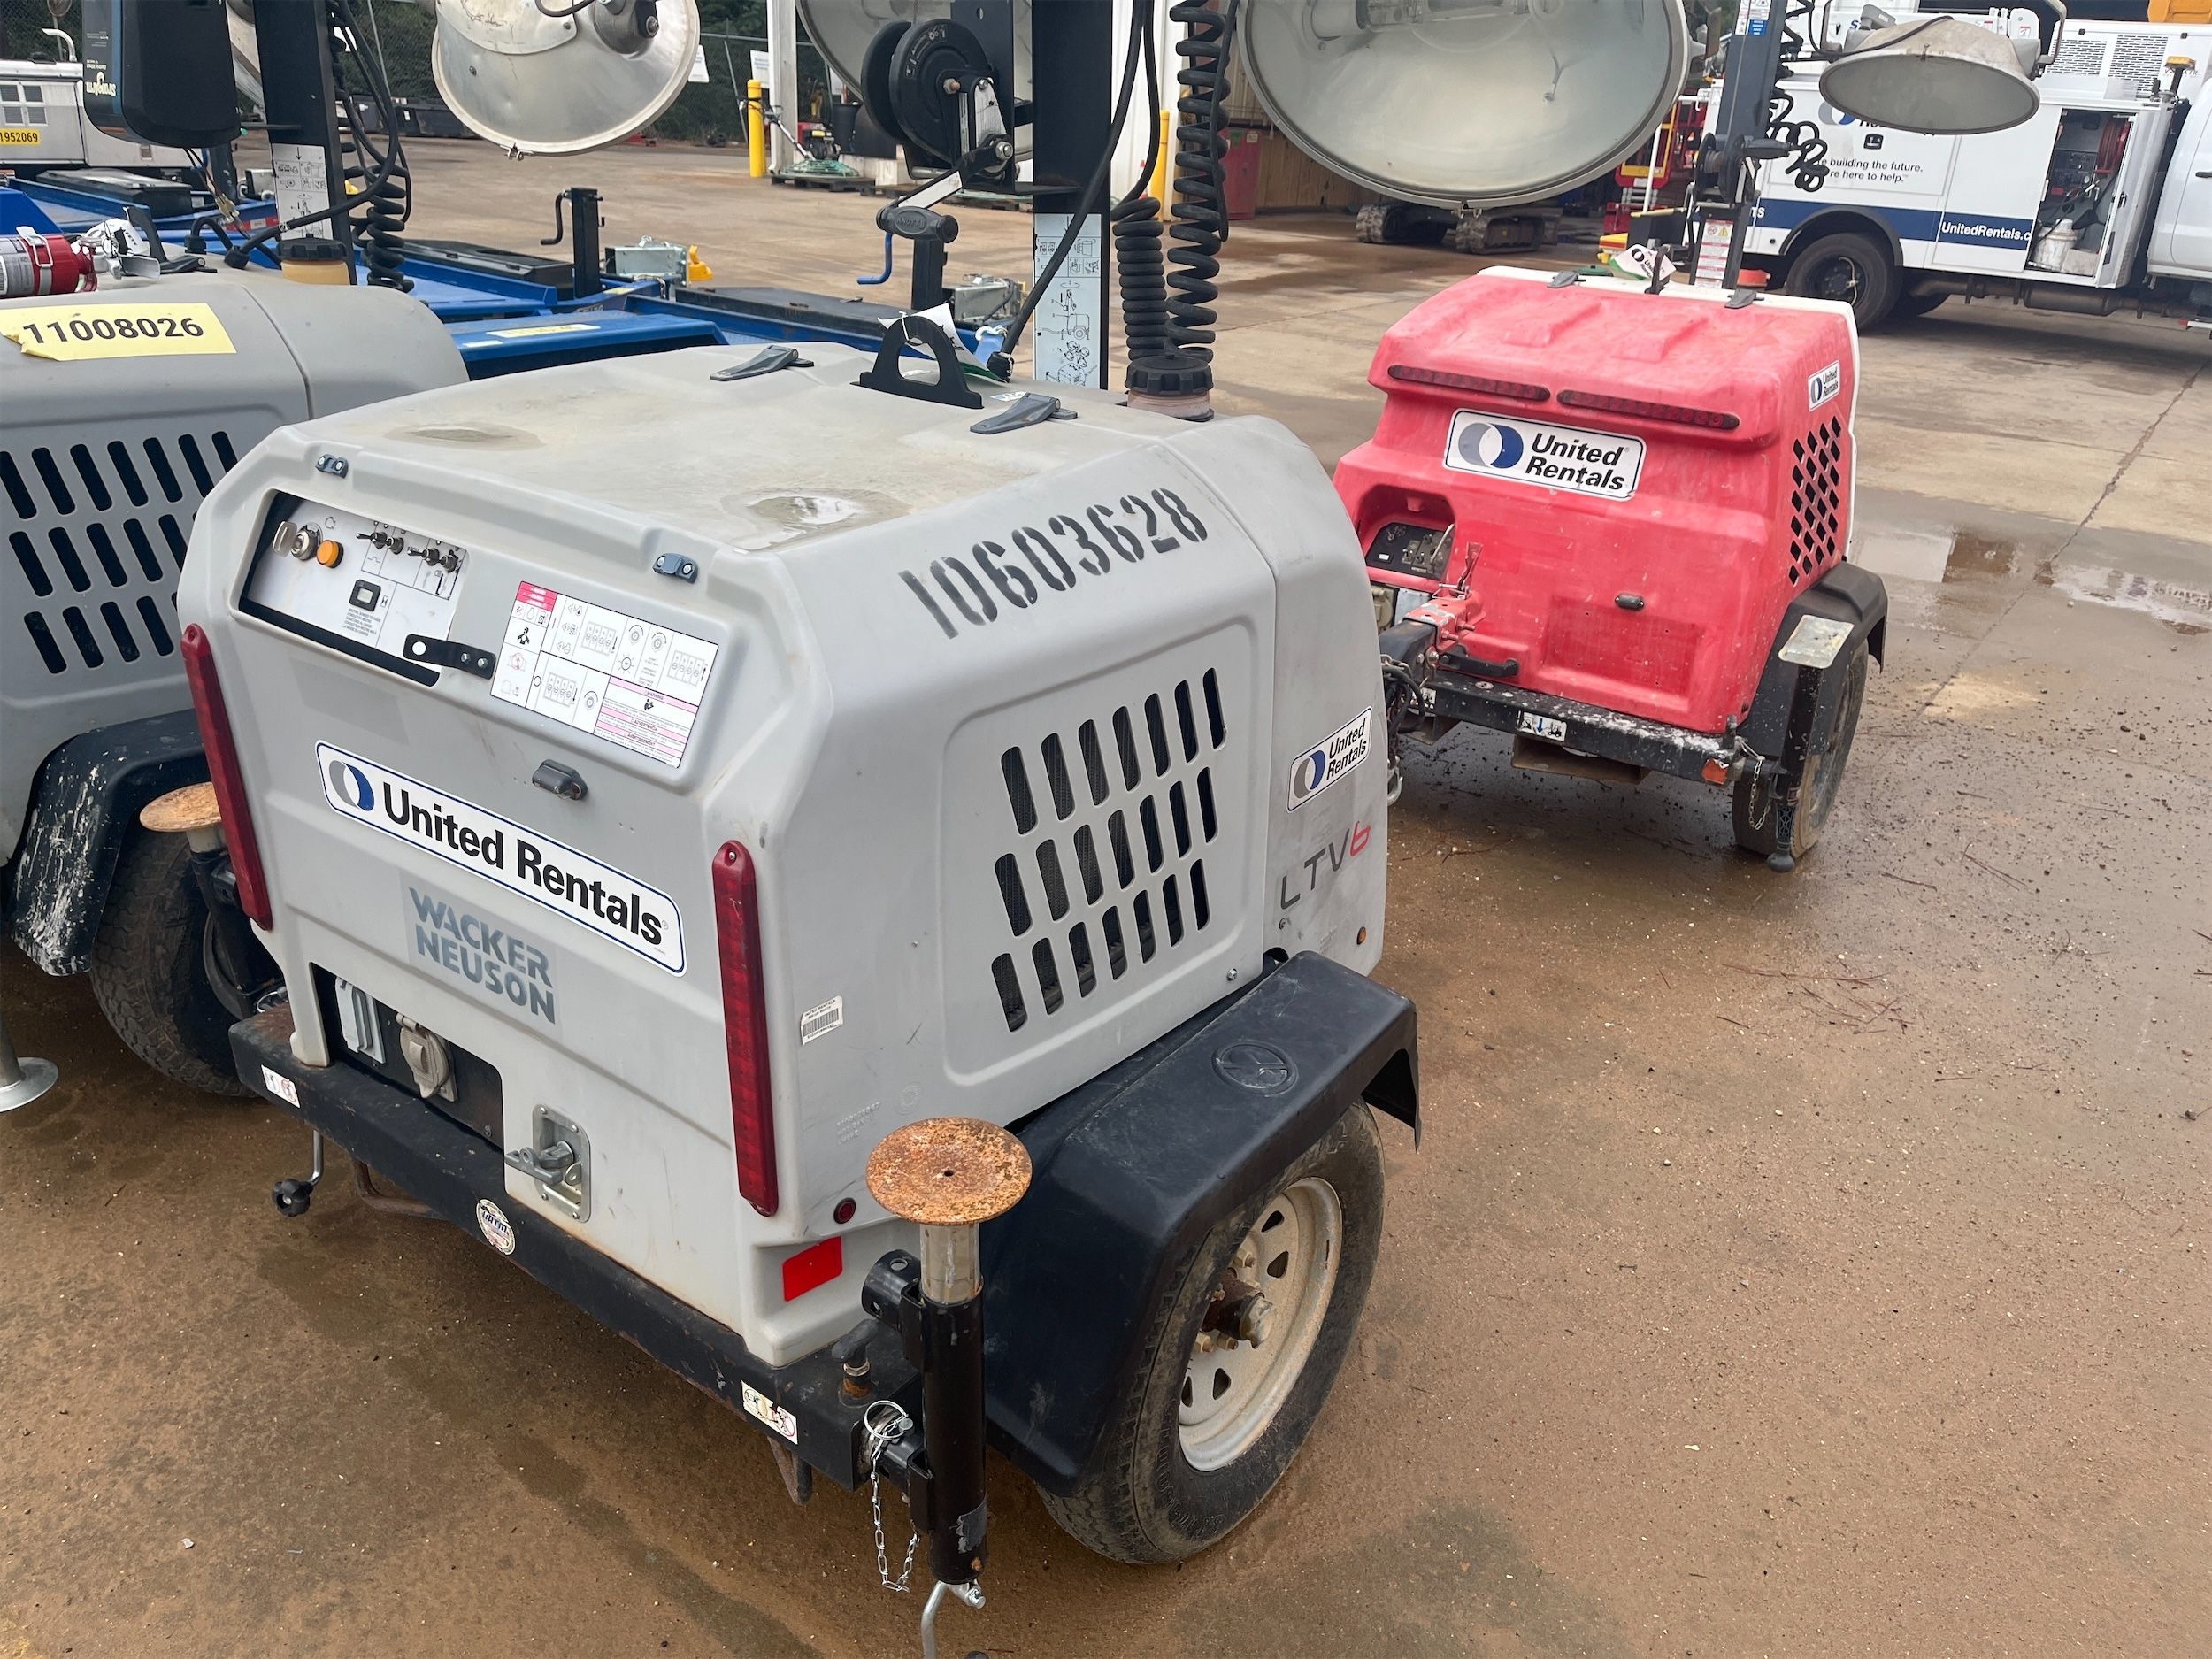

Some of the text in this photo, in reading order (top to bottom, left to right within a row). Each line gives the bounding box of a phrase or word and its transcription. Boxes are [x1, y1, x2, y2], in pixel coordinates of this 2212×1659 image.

[1829, 157, 1869, 171] building
[1872, 160, 1887, 169] the
[1891, 161, 1924, 173] future.
[1842, 170, 1864, 179] here
[23, 317, 204, 344] 11008026
[1532, 433, 1624, 467] United
[1525, 456, 1625, 490] Rentals
[897, 488, 1208, 640] 10603628
[1329, 718, 1367, 759] United
[1326, 739, 1368, 781] Rentals
[383, 782, 663, 946] United Rentals
[1280, 821, 1371, 910] LTV6
[409, 886, 554, 988] WACKER
[415, 925, 556, 1025] NEUSON
